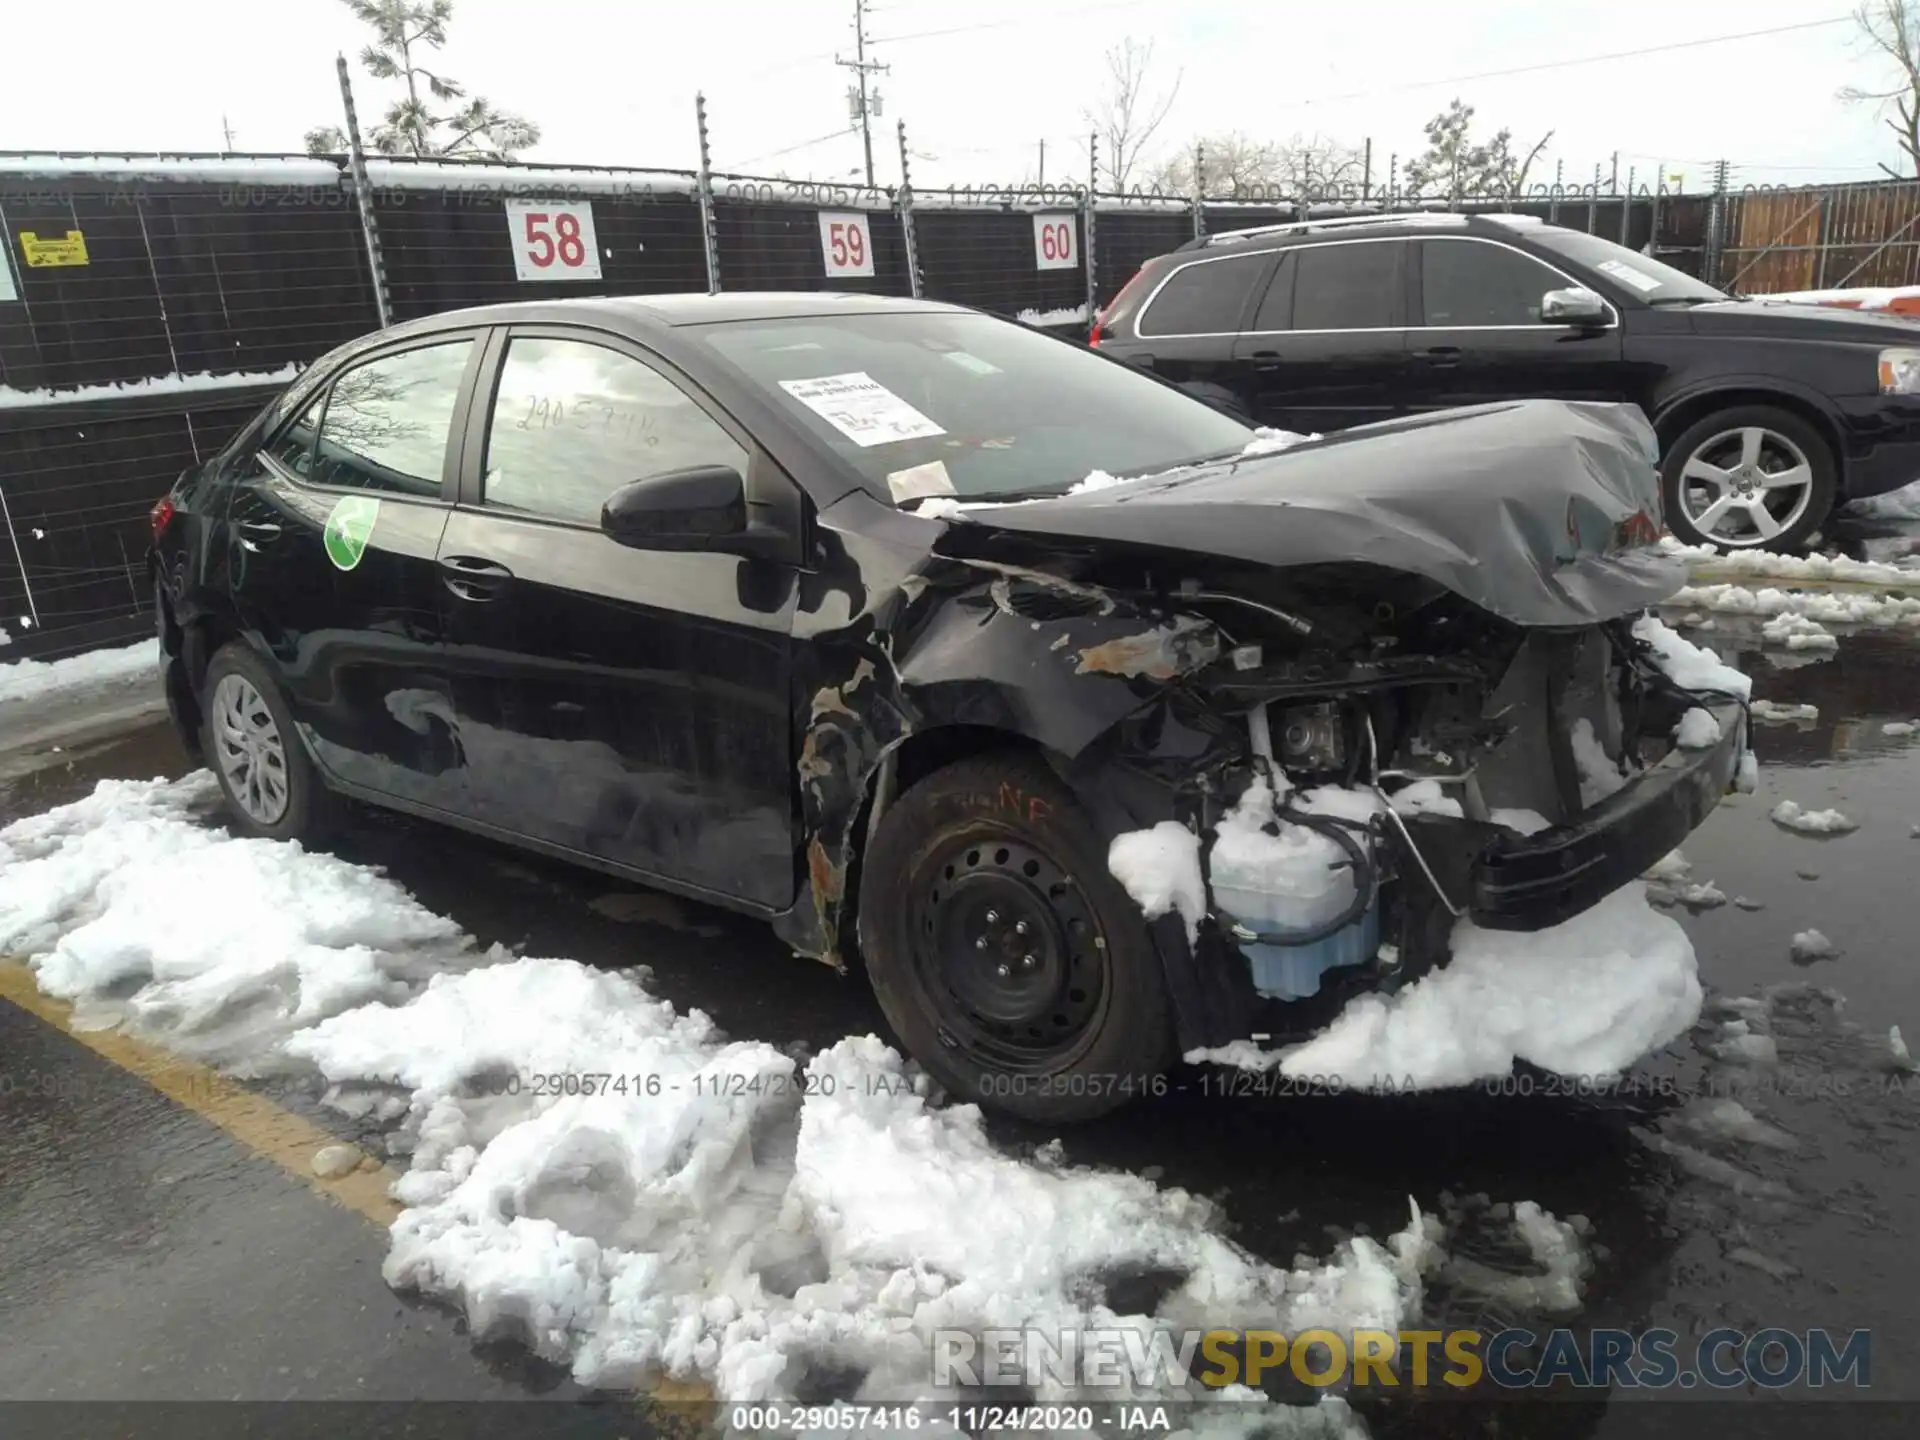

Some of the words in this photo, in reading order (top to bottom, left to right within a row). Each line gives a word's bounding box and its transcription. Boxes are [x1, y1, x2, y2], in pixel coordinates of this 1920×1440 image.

[525, 212, 585, 268] 58
[829, 223, 864, 267] 59
[1041, 223, 1070, 261] 60
